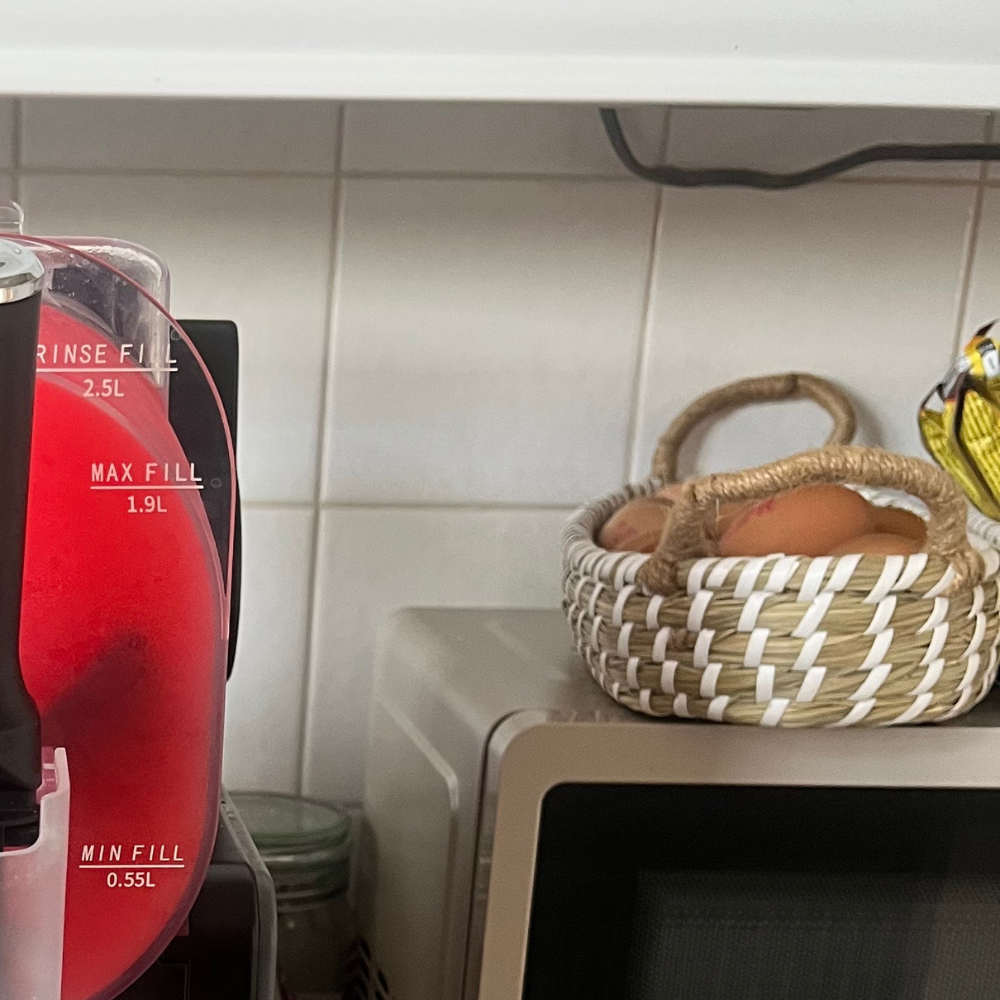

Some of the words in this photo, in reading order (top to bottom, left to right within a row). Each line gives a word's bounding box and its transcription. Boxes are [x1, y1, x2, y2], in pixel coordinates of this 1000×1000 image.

[36, 344, 107, 364] RINSE
[82, 379, 125, 397] 2.5L
[91, 462, 134, 482] MAX
[145, 462, 203, 482] FILL
[127, 495, 168, 513] 1.9L
[81, 845, 122, 862] MIN
[131, 845, 184, 861] FILL
[106, 872, 156, 888] 0.55L
